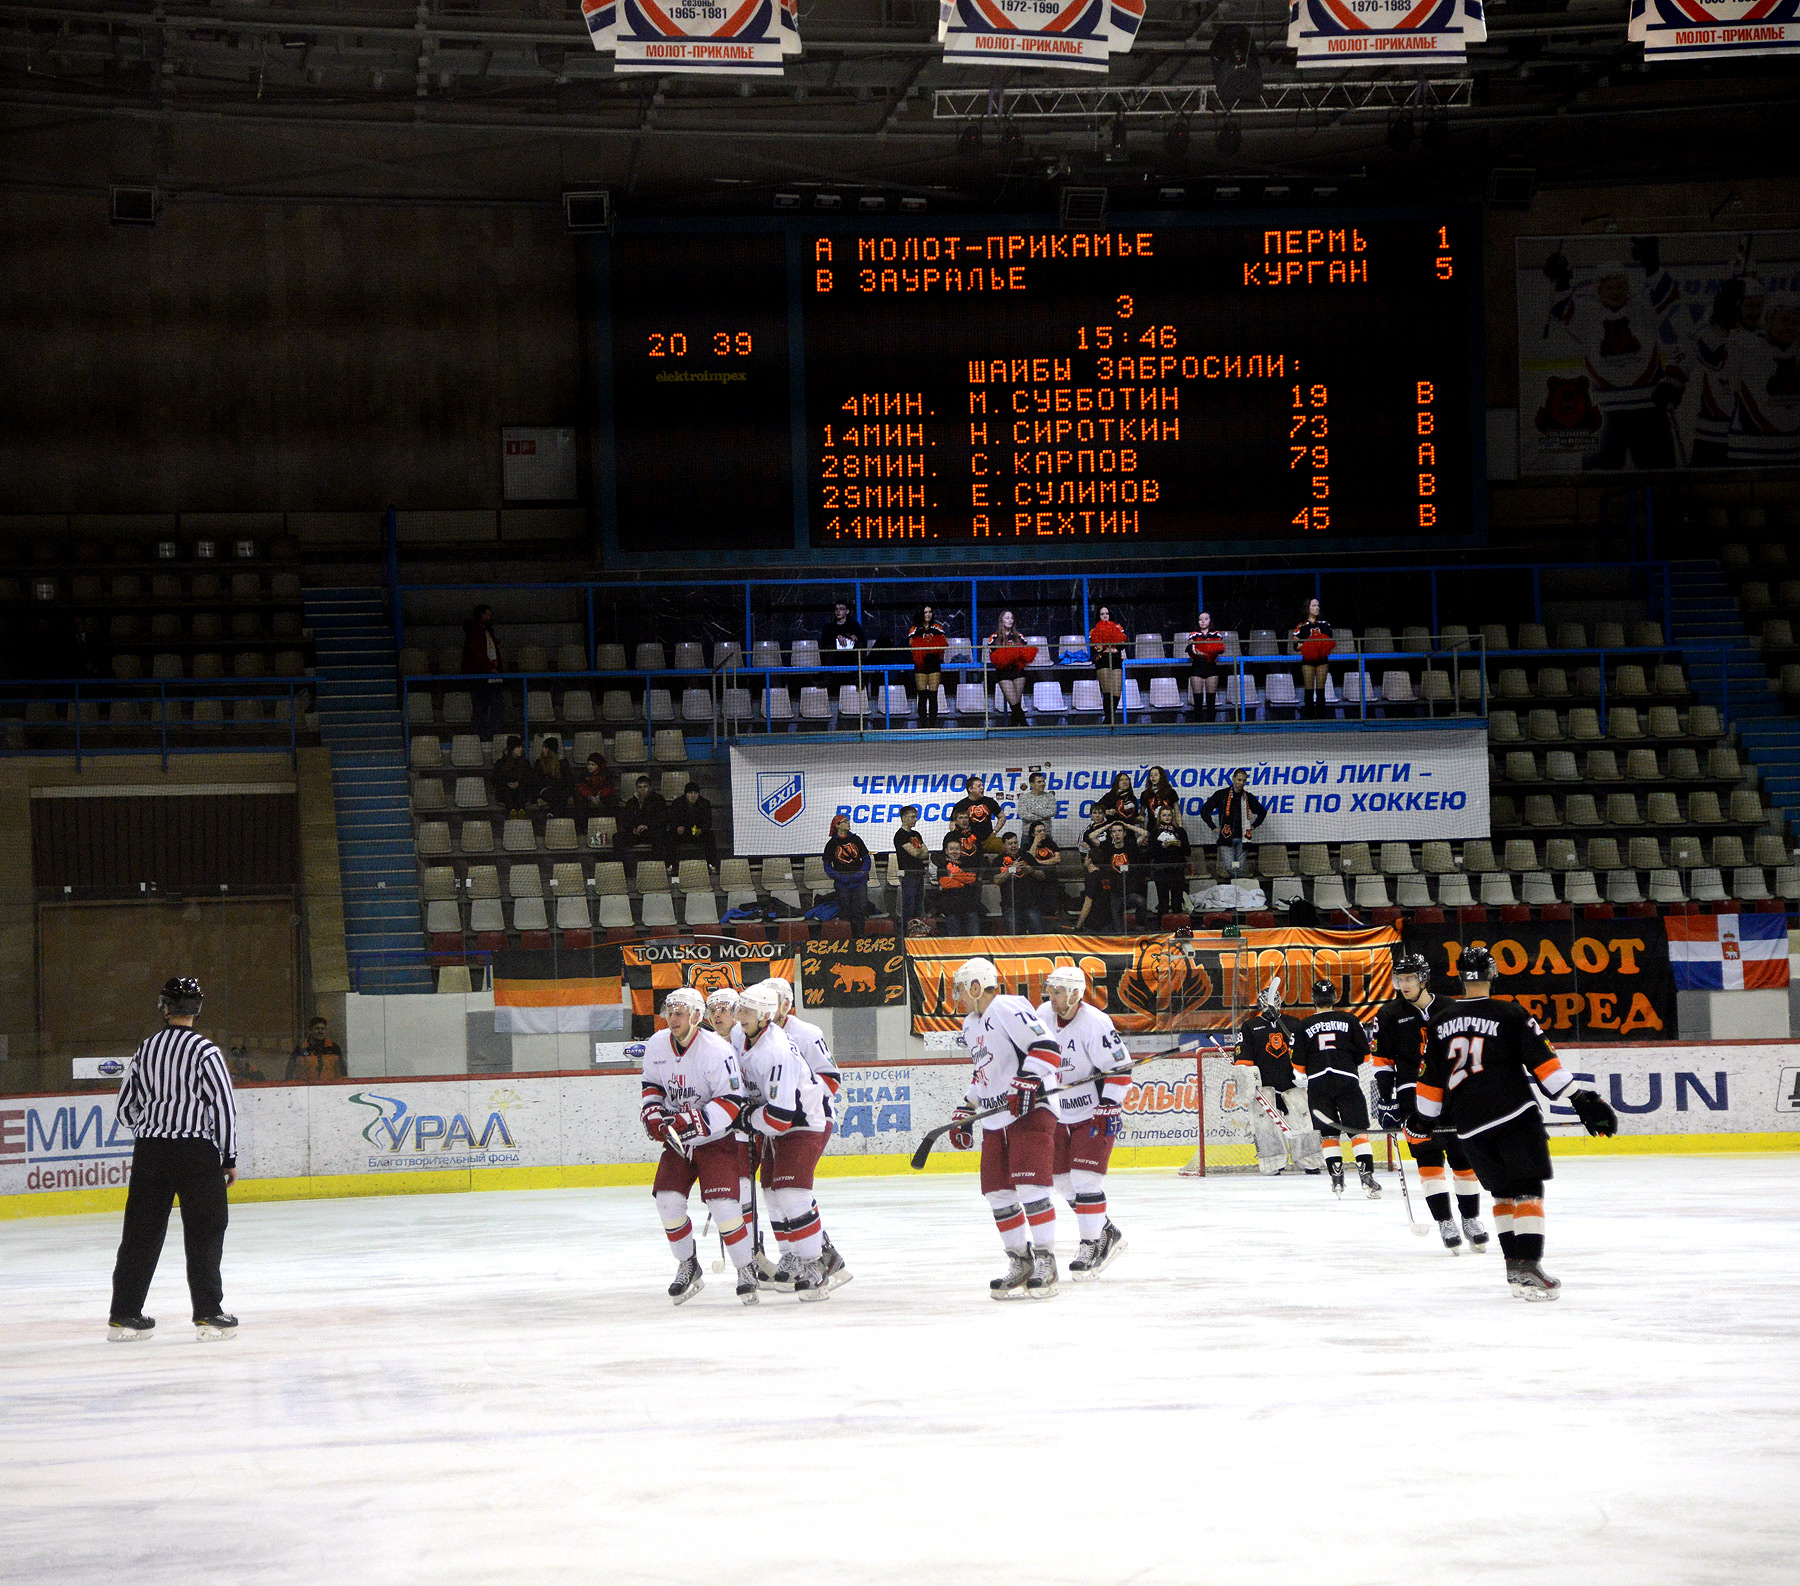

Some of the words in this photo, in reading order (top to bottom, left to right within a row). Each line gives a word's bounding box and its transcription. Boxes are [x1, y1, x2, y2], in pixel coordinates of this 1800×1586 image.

[669, 7, 728, 19] 1965-1981
[1001, 1, 1060, 14] 1972-1990
[1352, 0, 1412, 12] 1970-1983
[975, 36, 1084, 54] МОЛОТ-ПРИКАМЬЕ
[1328, 36, 1438, 52] МОЛОТ-ПРИКАМЬЕ
[1676, 27, 1785, 44] МОЛОТ-ПРИКАМЬЕ
[645, 44, 755, 59] МОЛОТ-ПРИКАМЬЕ
[859, 233, 1153, 261] МОЛОТ-ПРИКАМЬЕ
[1264, 229, 1367, 254] ПЕРМЬ
[1438, 226, 1449, 248] 1
[860, 266, 1026, 292] ЗАУРАЛЬЕ
[1244, 260, 1367, 285] КУРГАН
[1436, 257, 1452, 279] 5
[1117, 295, 1133, 318] 3
[648, 333, 687, 356] 20
[714, 332, 752, 356] 39
[1078, 325, 1177, 350] 15:46
[655, 370, 747, 384] elektroimpex
[1097, 354, 1300, 380] ЗАБРОСИЛИ:
[842, 392, 935, 416] 4МИН.
[1292, 384, 1327, 408] 19
[824, 424, 936, 447] 14МИН.
[1290, 415, 1328, 438] 73
[822, 454, 937, 478] 28МИН.
[1290, 445, 1329, 469] 79
[823, 485, 937, 508] 29МИН.
[1312, 476, 1329, 499] 5
[1291, 507, 1330, 530] 45
[1031, 764, 1150, 790] ЫСШЙ
[1337, 763, 1411, 783] ЛИГИ
[769, 783, 796, 810] ВХЛ
[1304, 793, 1341, 813] ПО
[1349, 791, 1467, 812] ХОККЕЮ
[634, 944, 711, 961] ТОЛЬКО
[719, 943, 786, 958] МОЛОТ
[806, 940, 850, 955] REAL
[856, 937, 896, 953] BEARS
[1466, 971, 1479, 979] 21
[1490, 991, 1663, 1034] ЕРЕД
[1306, 1021, 1349, 1038] ВЕРЕВКИН
[1437, 1017, 1500, 1040] ЗАХАРЧУК
[1102, 1030, 1121, 1050] 43
[769, 1064, 783, 1082] 11
[1447, 1036, 1485, 1090] 21
[866, 1070, 910, 1080] РОССИИ
[381, 1112, 517, 1152] УРАЛ
[1131, 1127, 1198, 1140] питьевой
[368, 1153, 486, 1168] Благотворительный
[488, 1151, 520, 1164] фонд
